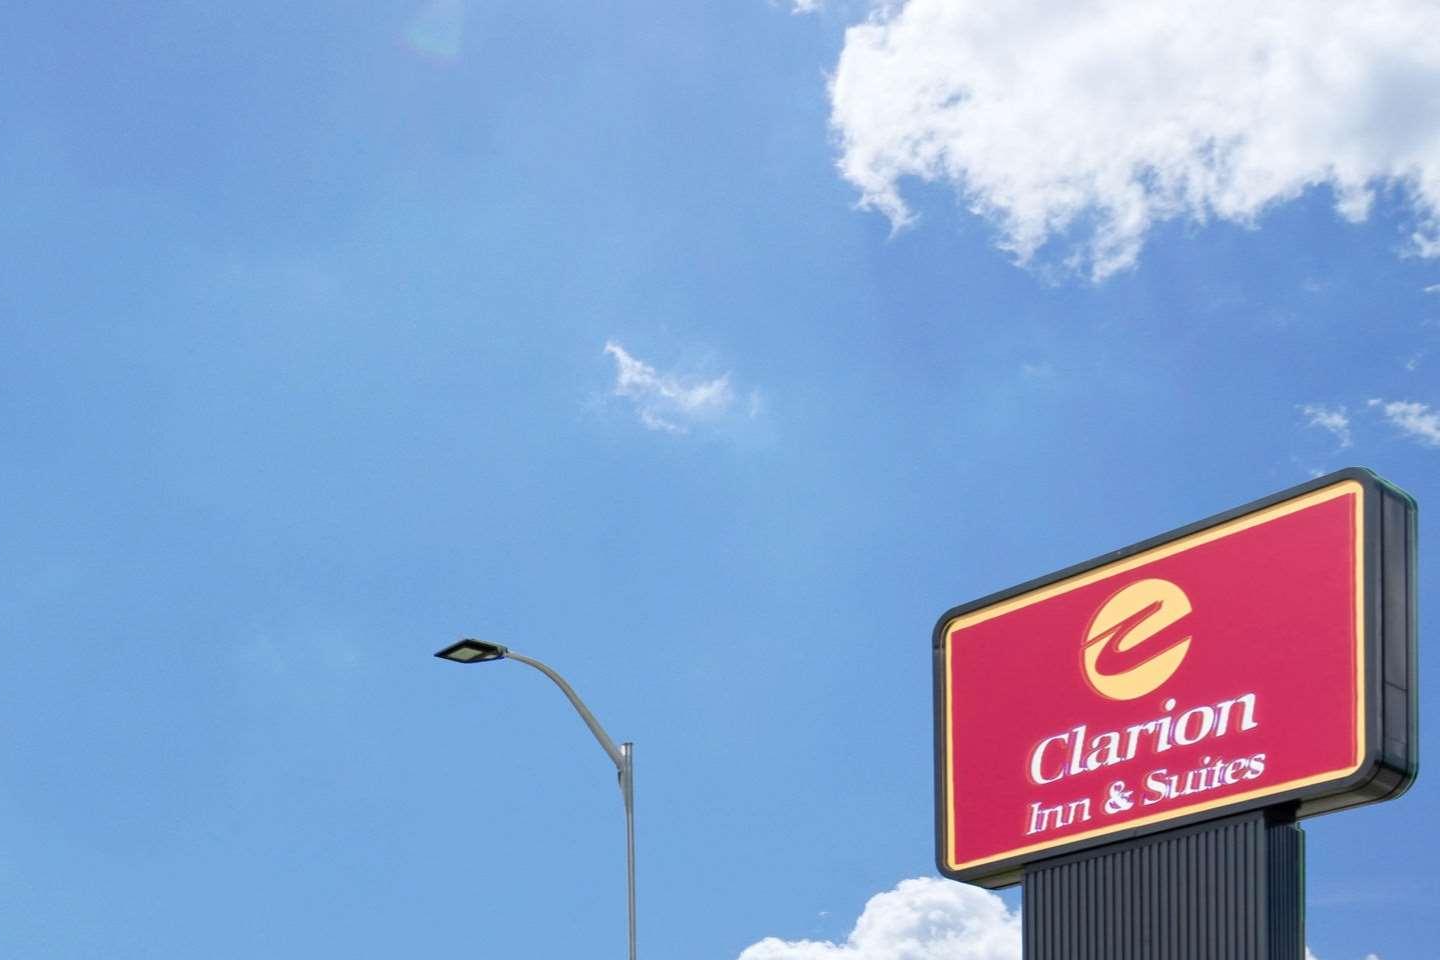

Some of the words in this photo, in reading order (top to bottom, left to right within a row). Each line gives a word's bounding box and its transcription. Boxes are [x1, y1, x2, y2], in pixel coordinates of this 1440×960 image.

[1028, 692, 1259, 785] Clarion
[1024, 798, 1092, 836] Inn
[1103, 780, 1135, 814] &
[1142, 752, 1267, 806] Suites
